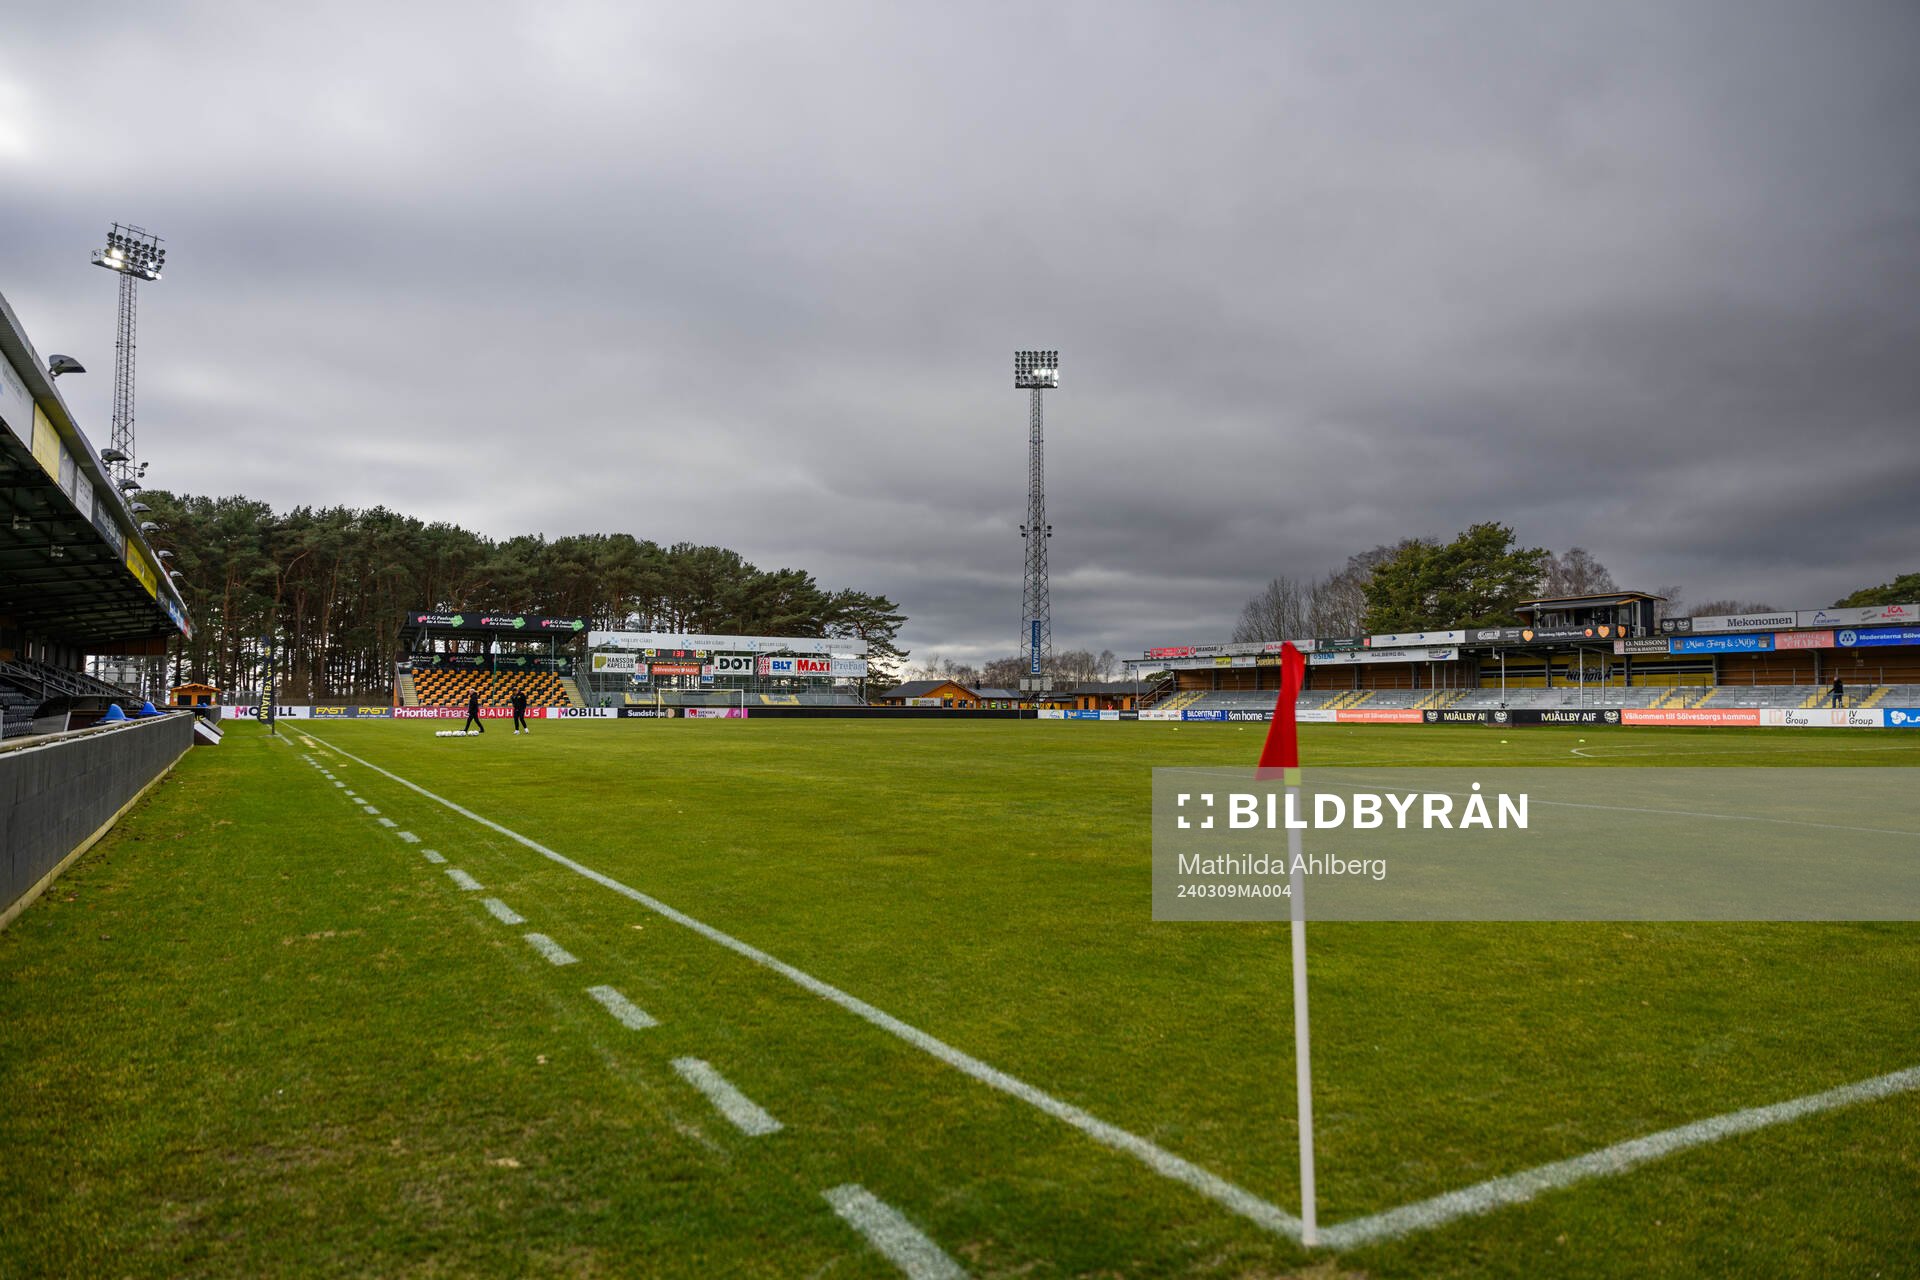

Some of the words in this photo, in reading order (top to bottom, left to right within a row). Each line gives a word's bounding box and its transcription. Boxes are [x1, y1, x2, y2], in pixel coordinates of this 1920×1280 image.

[1887, 605, 1903, 613] ICA
[1727, 616, 1792, 627] Mekonomen
[1859, 633, 1901, 641] Moderaterna
[1727, 640, 1733, 648] &
[772, 661, 792, 670] BLT
[235, 706, 296, 718] MOILL
[394, 707, 438, 717] Prioritet
[439, 707, 470, 717] Finans
[479, 708, 540, 717] BAUHUS
[558, 708, 607, 718] MOBILL
[1241, 710, 1263, 720] home
[1443, 711, 1472, 721] MJÄLLBY
[1541, 712, 1580, 722] MJÄLLBY
[1581, 712, 1597, 722] AIF
[1624, 712, 1664, 721] Välkommen
[1665, 712, 1675, 721] till
[1676, 712, 1721, 722] Sölvesborgs
[1722, 712, 1757, 721] kommun
[1785, 717, 1809, 725] Group
[1848, 717, 1873, 725] Group
